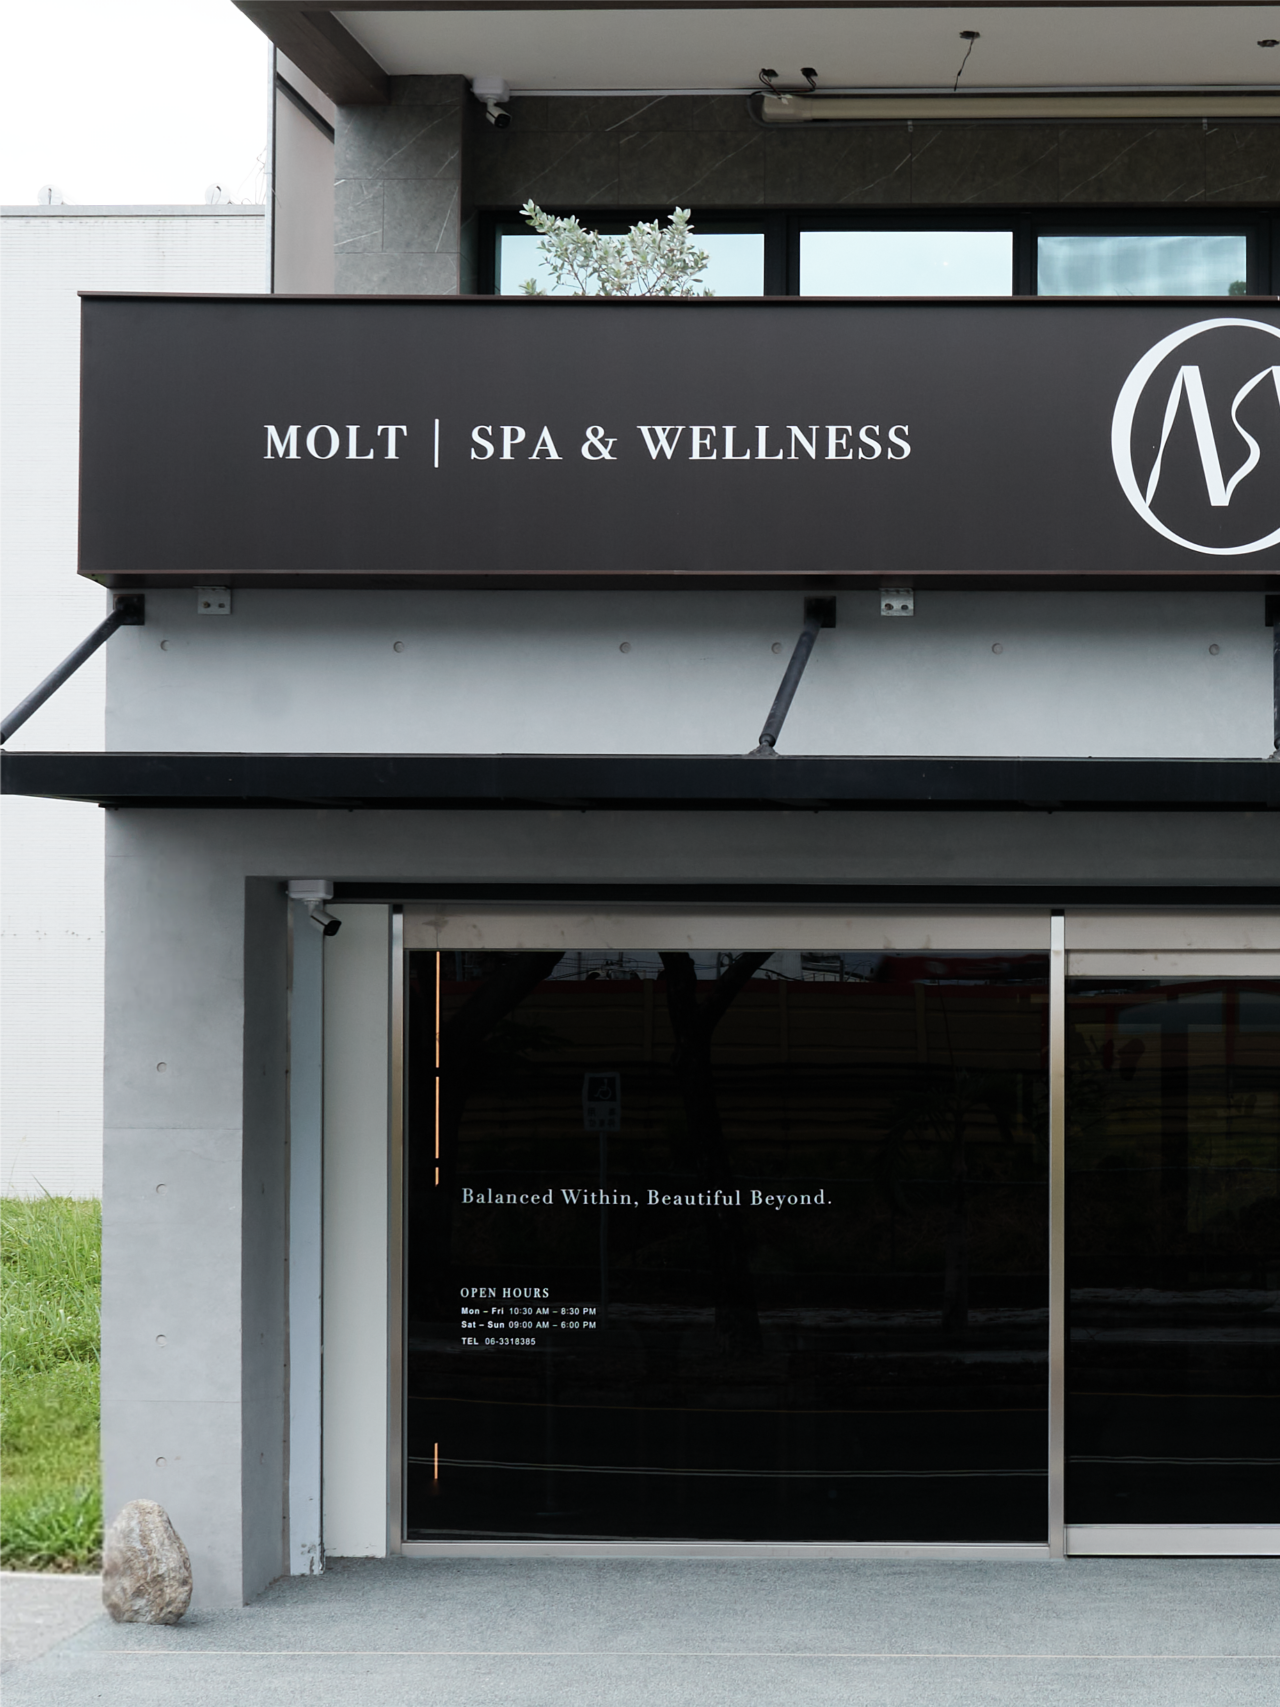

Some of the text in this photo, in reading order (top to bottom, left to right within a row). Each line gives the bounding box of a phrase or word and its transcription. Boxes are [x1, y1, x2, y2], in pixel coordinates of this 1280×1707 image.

[263, 424, 408, 460] MOLT
[470, 425, 564, 461] SPA
[580, 425, 618, 461] &
[636, 424, 912, 461] WELLNESS
[462, 1187, 832, 1211] Balanced Within, Beautiful Beyond.
[460, 1287, 550, 1299] OPEN HOURS
[461, 1307, 480, 1315] Mon
[491, 1307, 504, 1315] Fri
[509, 1307, 533, 1315] 10:30
[535, 1307, 550, 1315] AM
[560, 1307, 580, 1315] 8:30
[582, 1307, 597, 1315] PM
[461, 1320, 476, 1329] Sat
[487, 1320, 505, 1329] Sun
[508, 1320, 533, 1329] 09:00
[535, 1320, 550, 1329] AM
[560, 1320, 580, 1329] 6:00
[582, 1320, 597, 1329] PM
[461, 1337, 536, 1346] TEL 06-3318385
